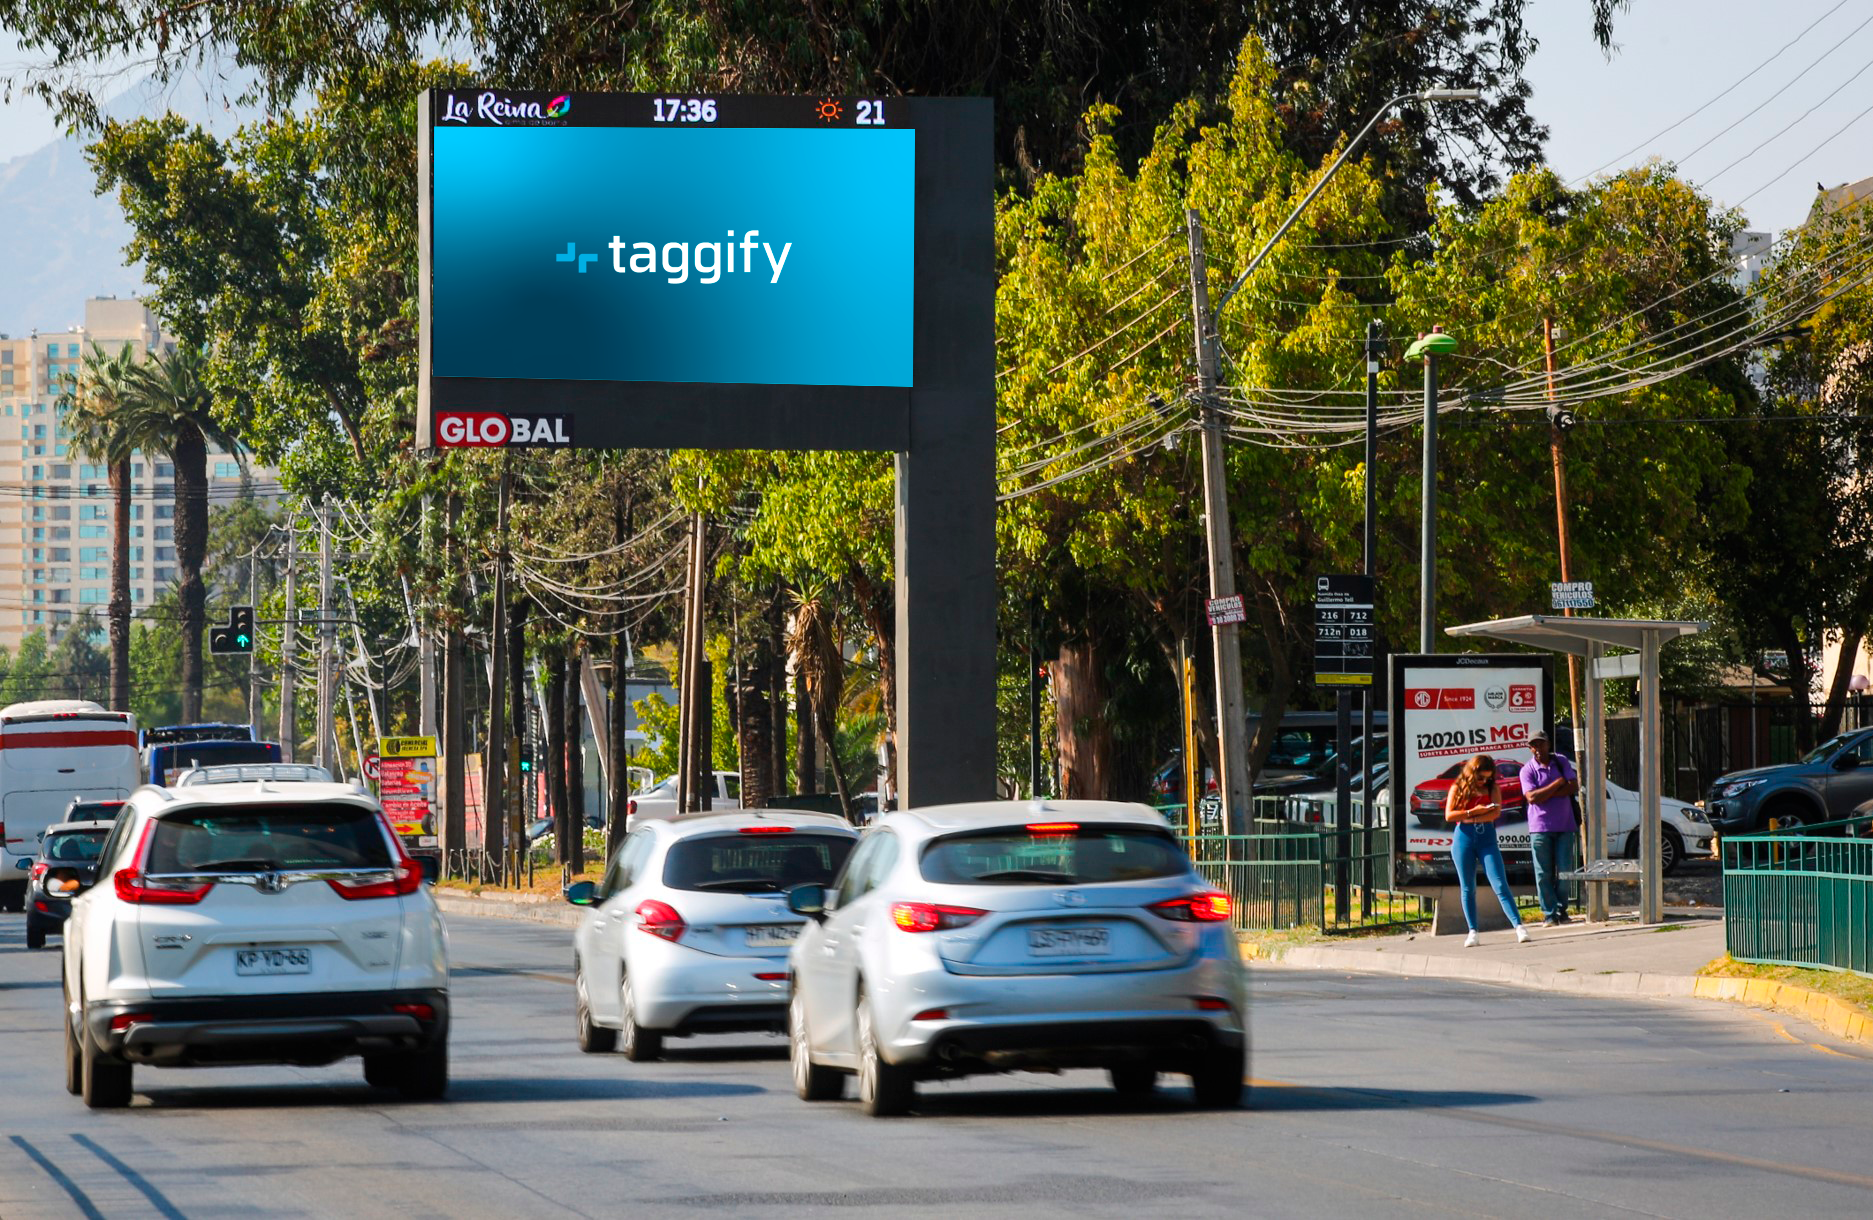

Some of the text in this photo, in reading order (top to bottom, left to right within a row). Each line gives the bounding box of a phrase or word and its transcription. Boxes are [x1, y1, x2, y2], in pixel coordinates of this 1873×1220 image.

[442, 92, 547, 125] La Reina
[653, 98, 718, 123] 17:36
[855, 100, 886, 125] 21
[608, 230, 793, 284] taggify
[440, 416, 570, 443] GLOBAL
[1552, 582, 1593, 591] COMPRO
[1321, 611, 1367, 620] 216 712
[1318, 628, 1367, 637] 712n D18
[1512, 691, 1523, 706] 6
[1468, 728, 1487, 746] IS
[1489, 722, 1529, 743] MG!
[1479, 744, 1502, 752] MARCA
